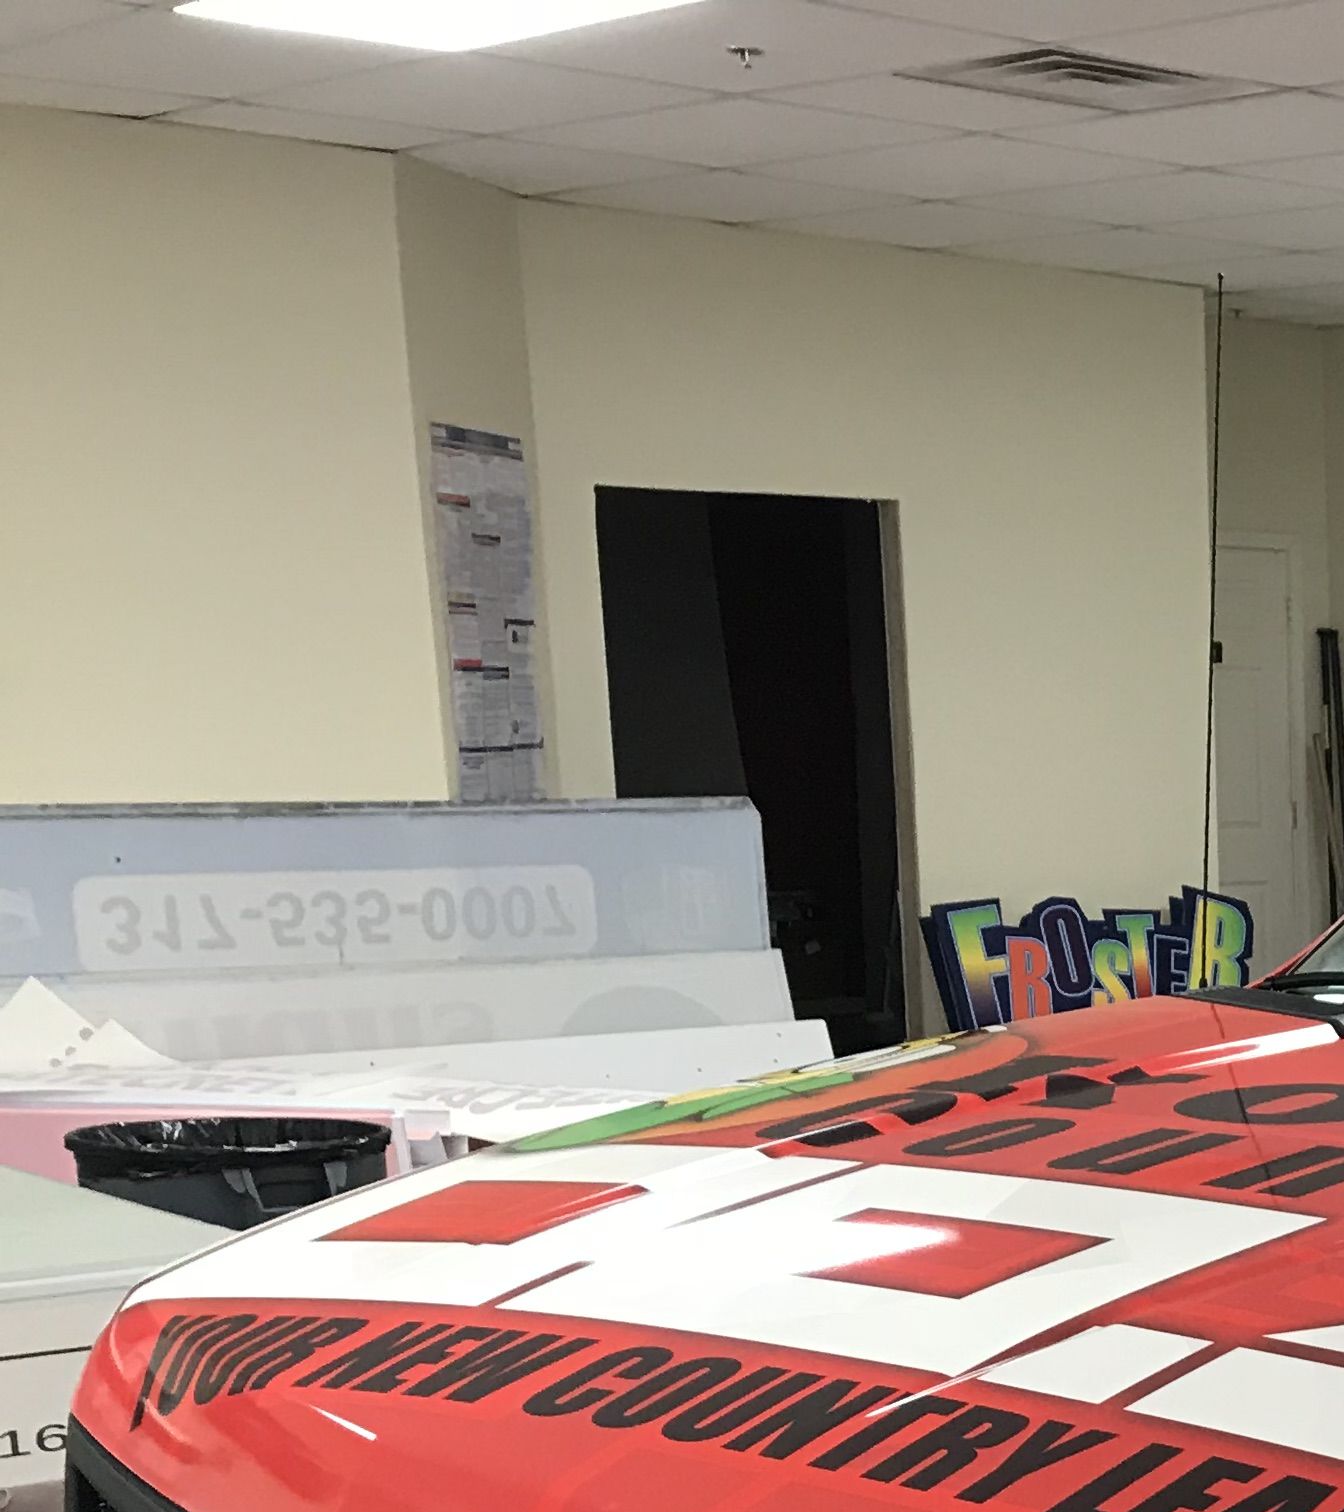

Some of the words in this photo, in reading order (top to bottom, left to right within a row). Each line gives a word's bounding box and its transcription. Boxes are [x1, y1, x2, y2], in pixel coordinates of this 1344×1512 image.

[947, 895, 1248, 1030] FROSTER
[130, 1313, 371, 1433] YOUR
[291, 1320, 583, 1404] NEW
[522, 1346, 1119, 1505] COUNTRY
